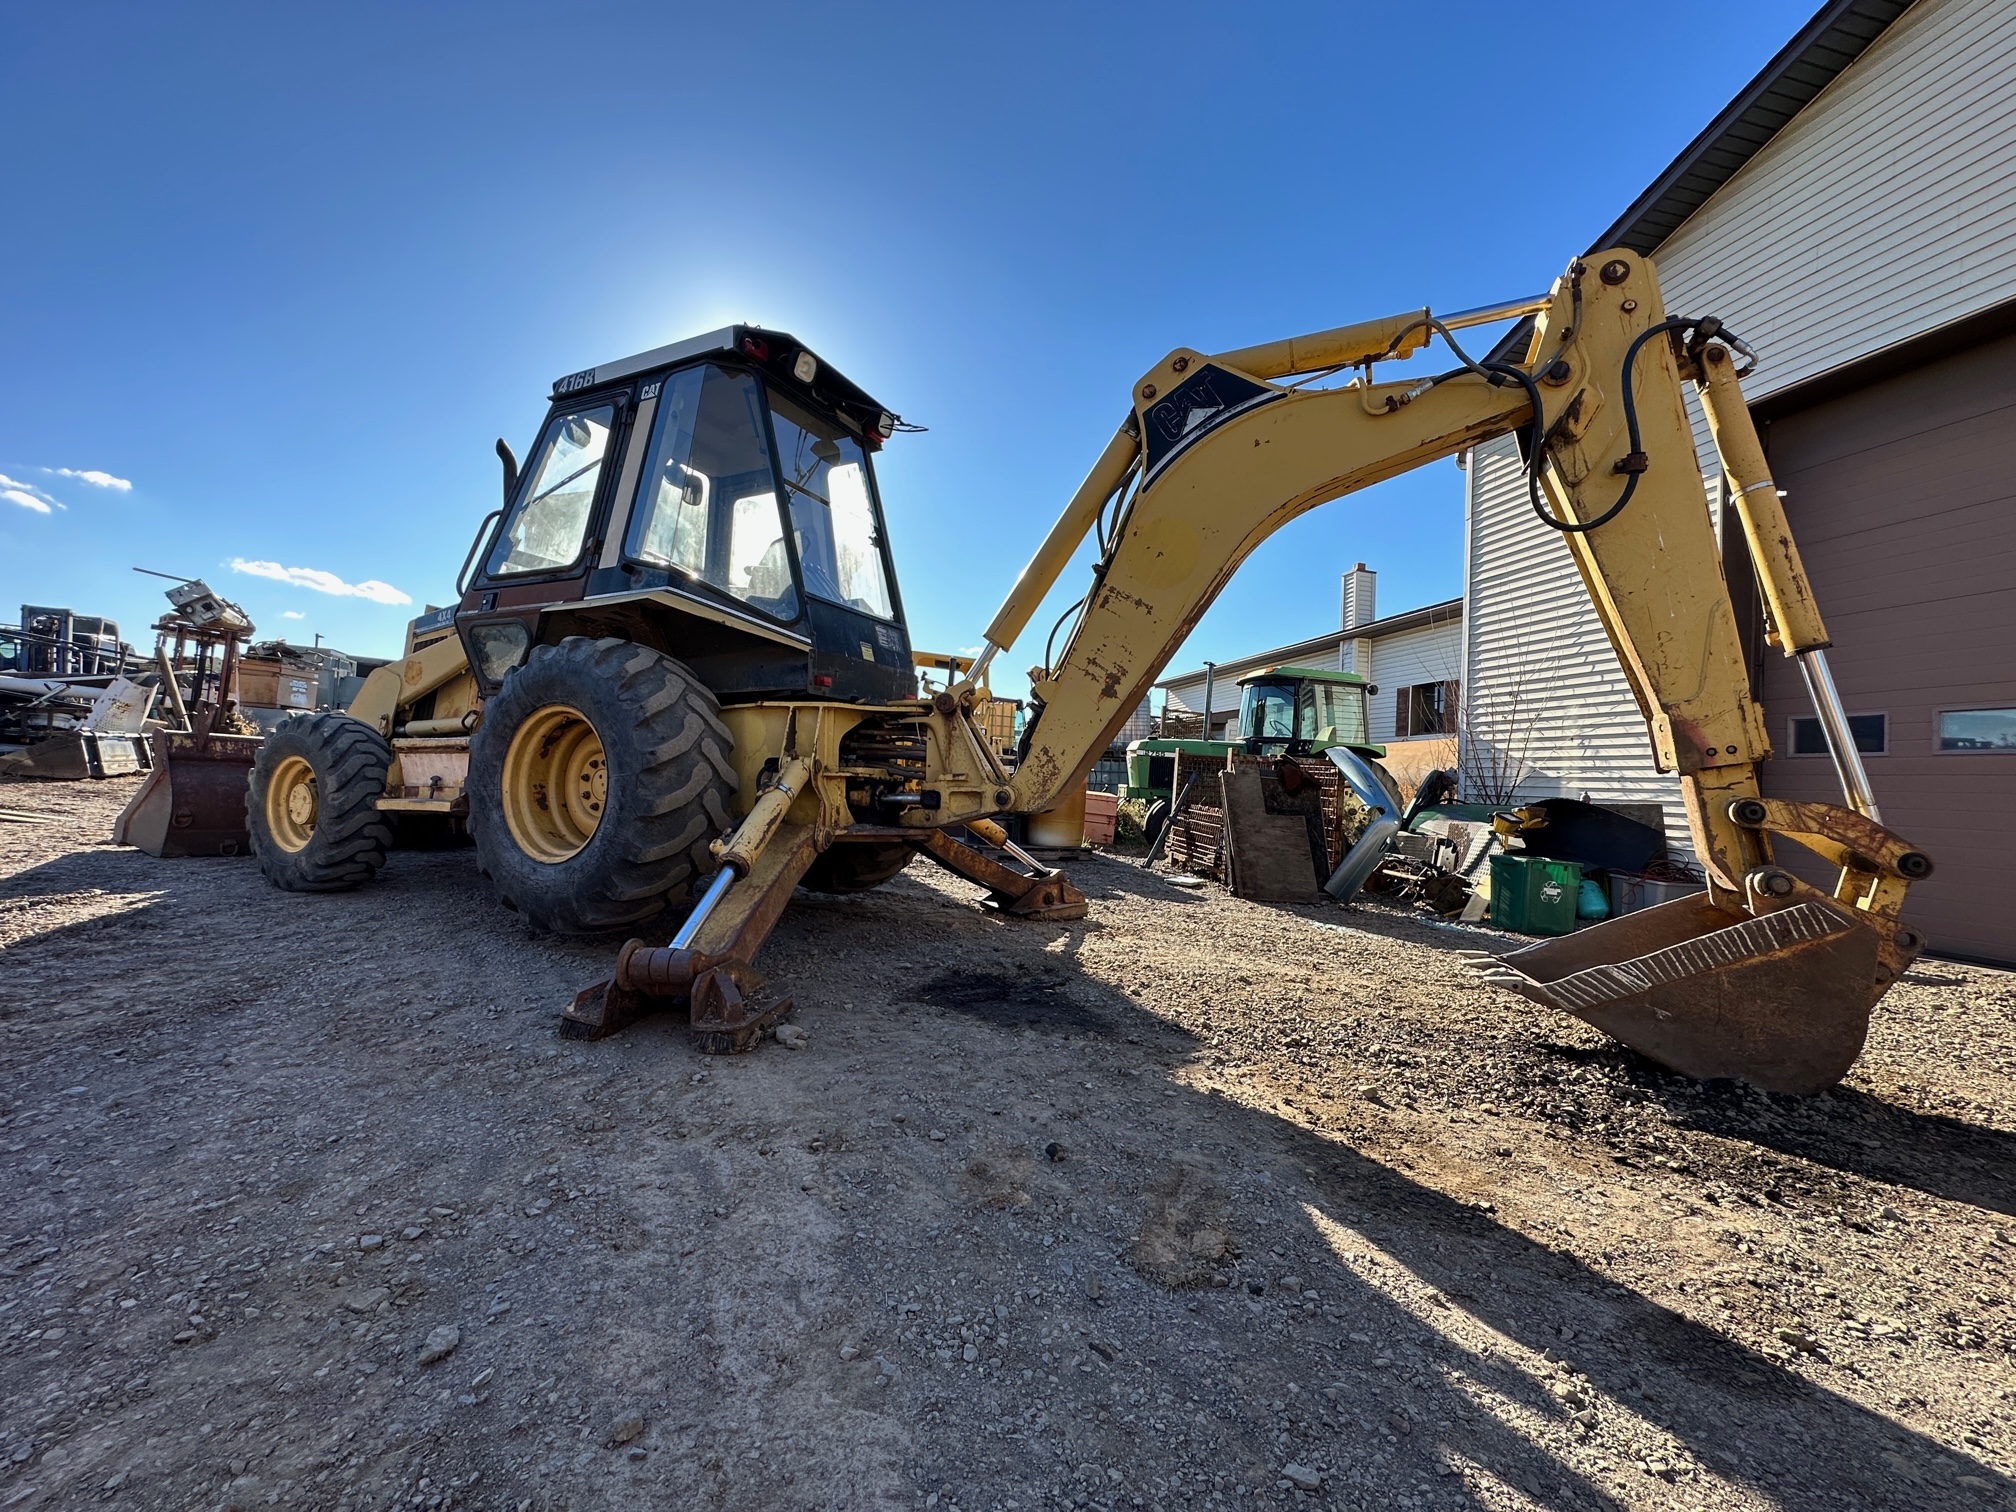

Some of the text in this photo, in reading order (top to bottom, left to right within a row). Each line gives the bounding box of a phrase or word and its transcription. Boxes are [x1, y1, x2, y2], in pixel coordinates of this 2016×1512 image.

[558, 369, 595, 393] 416B
[641, 382, 662, 400] CAT
[1152, 371, 1225, 441] CAT
[437, 609, 451, 622] 4X4
